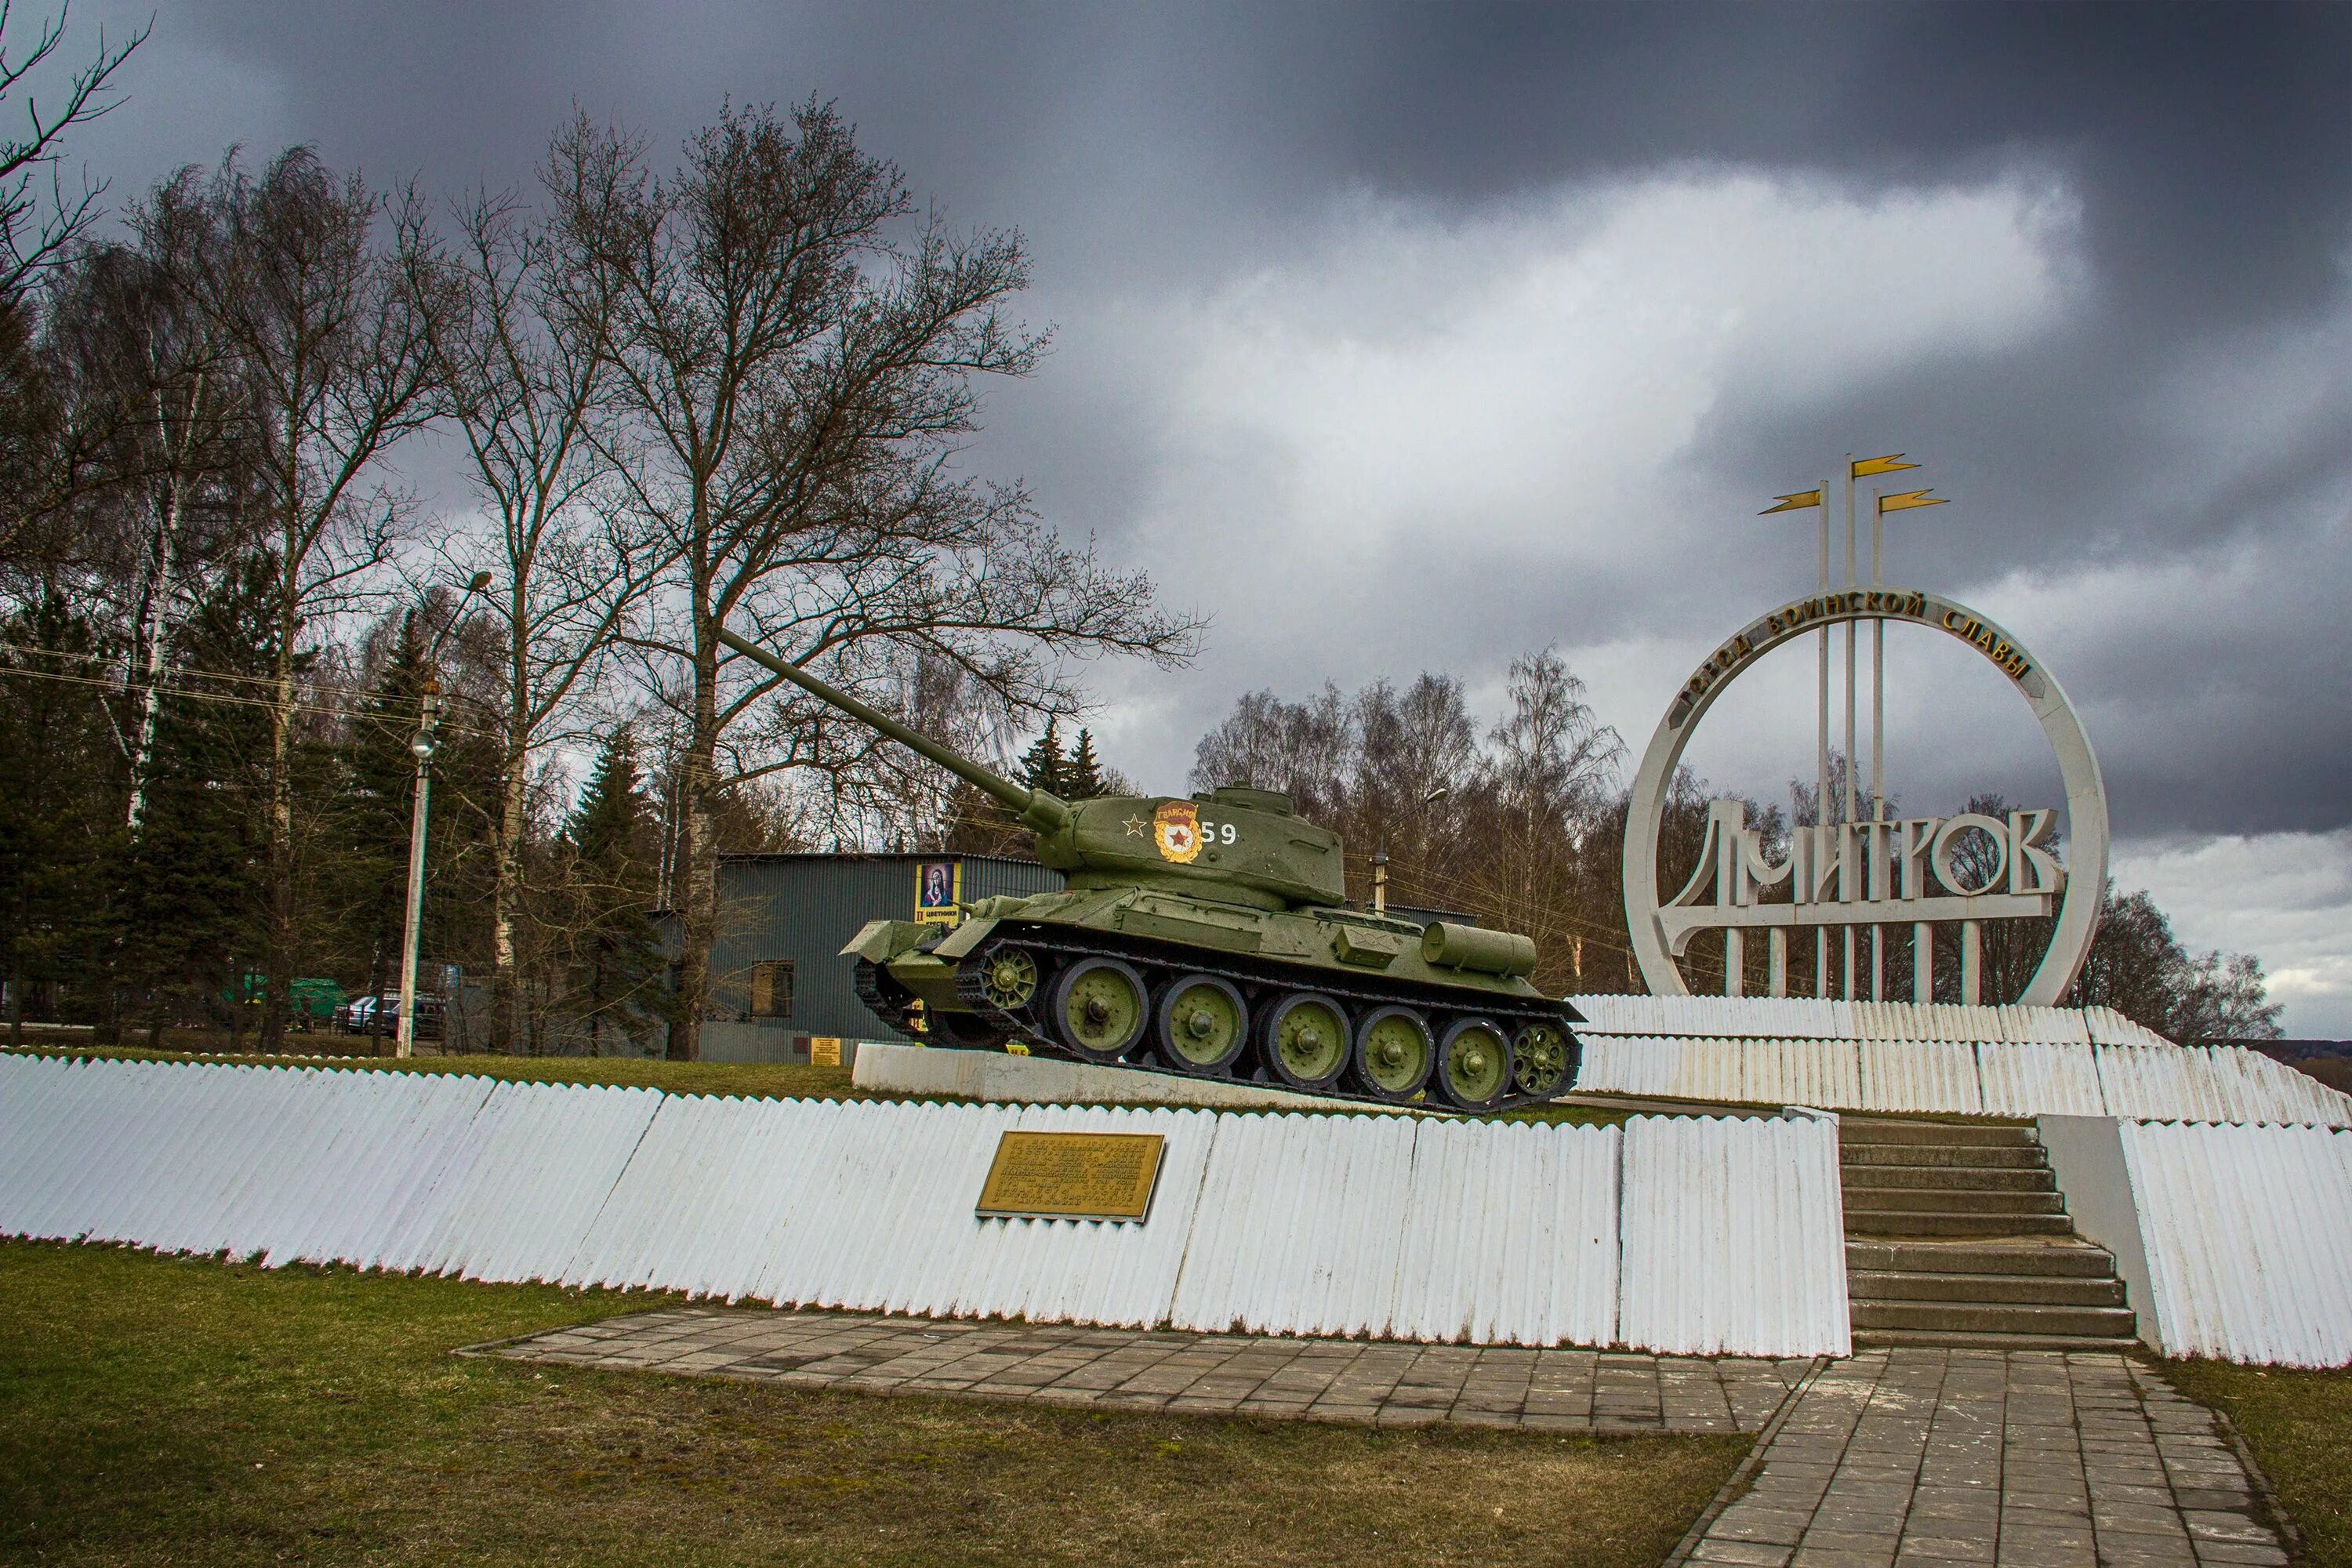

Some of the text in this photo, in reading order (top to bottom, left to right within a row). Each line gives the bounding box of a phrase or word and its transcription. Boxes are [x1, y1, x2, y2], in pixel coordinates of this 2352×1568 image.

[1679, 590, 2029, 708] ГОРОД ВОИНСКОЙ СЛАВЫ
[1158, 808, 1195, 819] ГВАРДИЯ
[1202, 822, 1236, 844] 59
[1657, 800, 2065, 955] ДМИТРОВ
